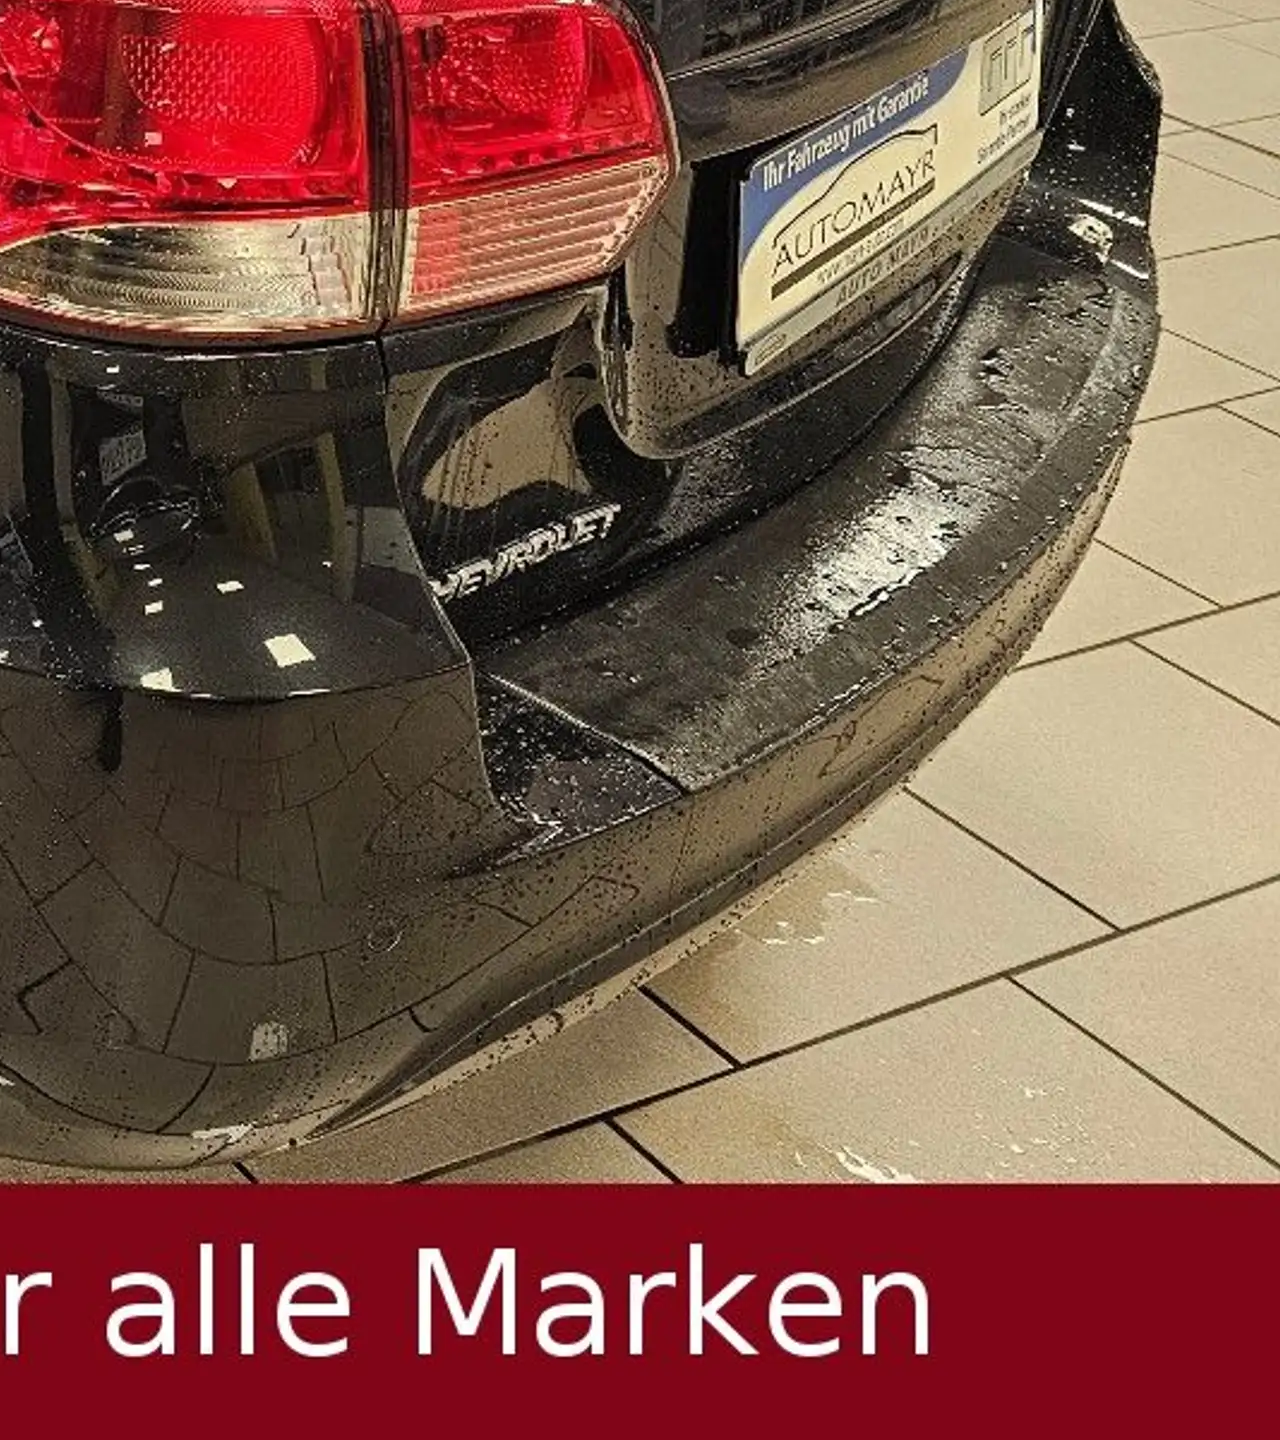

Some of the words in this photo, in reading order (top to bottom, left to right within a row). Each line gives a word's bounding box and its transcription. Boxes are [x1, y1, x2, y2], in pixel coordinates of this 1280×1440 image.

[763, 160, 785, 193] Ihr
[788, 124, 851, 180] Fahrzeug
[852, 105, 878, 139] mit
[877, 72, 930, 123] Garantie
[771, 148, 936, 278] AUTOMAYR
[427, 503, 622, 605] HEVROLET
